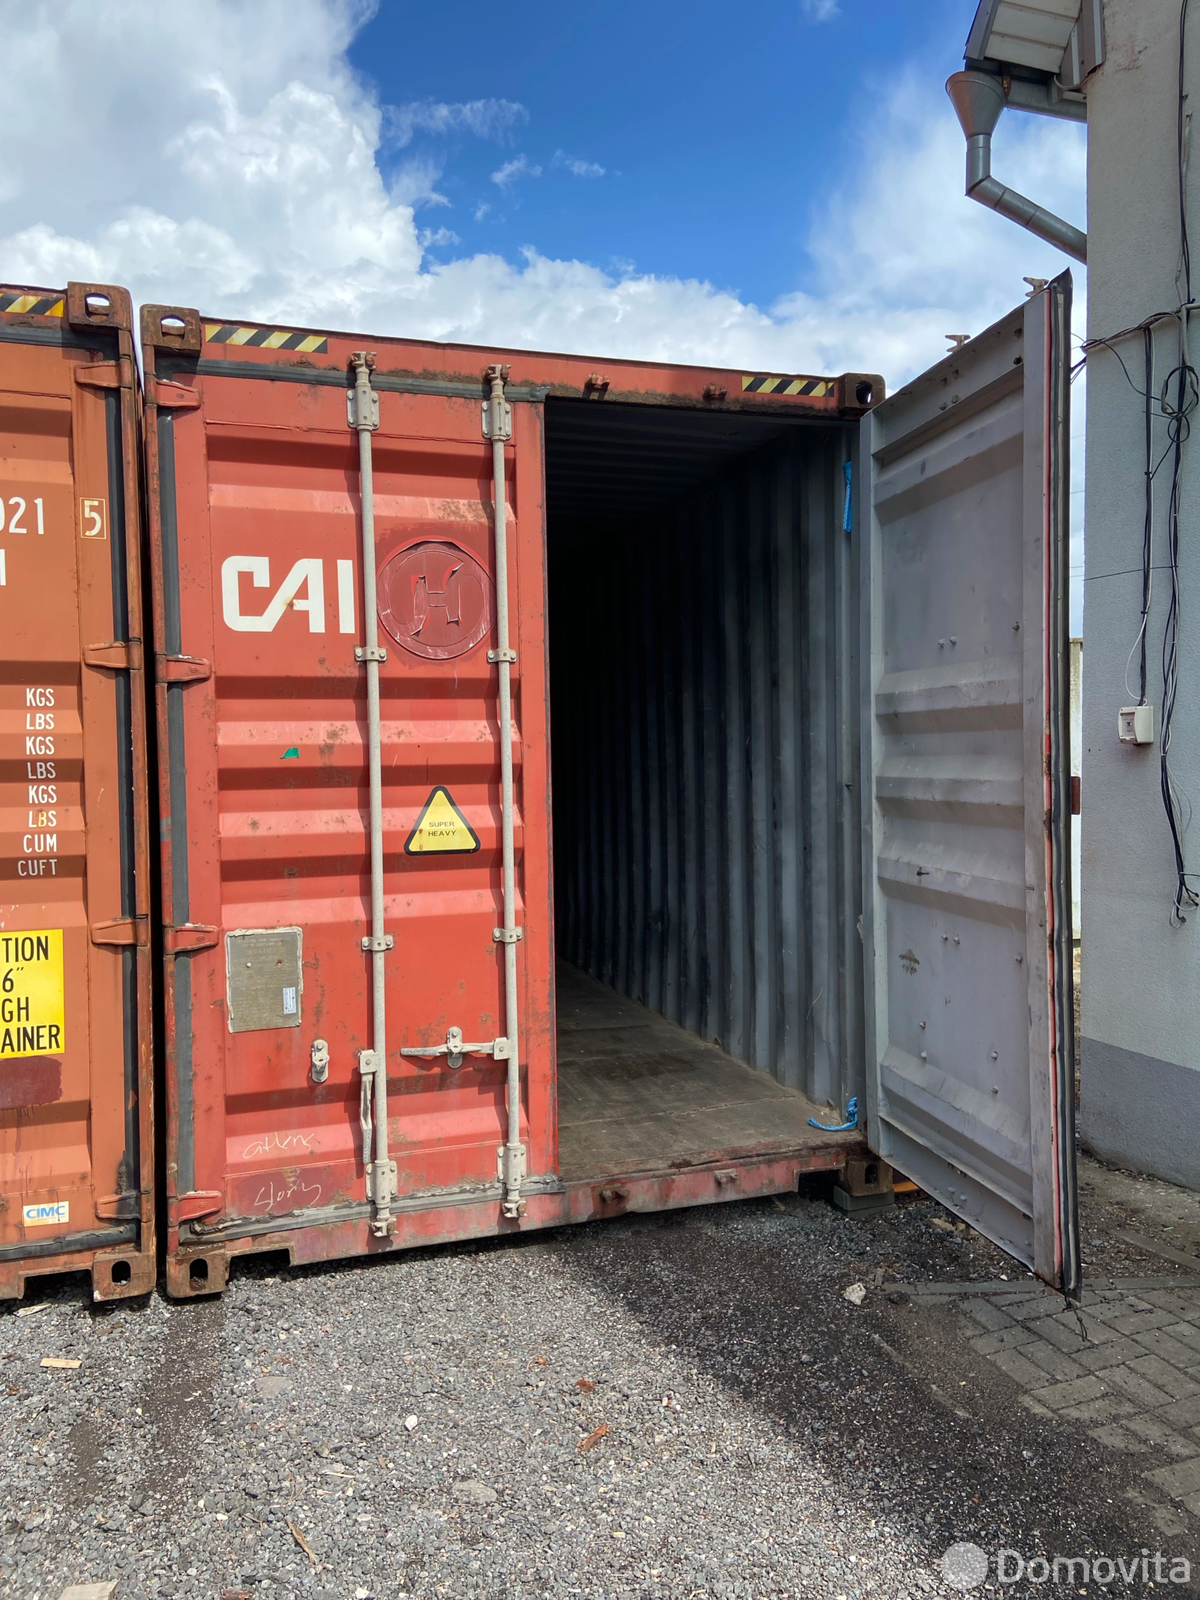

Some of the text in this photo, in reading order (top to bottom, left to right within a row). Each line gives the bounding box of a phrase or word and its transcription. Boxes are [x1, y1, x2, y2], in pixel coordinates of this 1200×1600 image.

[84, 499, 102, 537] 5
[221, 555, 356, 634] CAI
[26, 688, 55, 707] KGS
[26, 713, 55, 730] LBS
[26, 736, 55, 755] KGS
[27, 762, 56, 779] LBS
[28, 785, 57, 804] KGS
[28, 810, 57, 828] LBS
[2, 936, 49, 963] TION
[1, 996, 29, 1023] GH
[1, 1024, 60, 1054] AINER
[26, 1205, 65, 1219] CIMC
